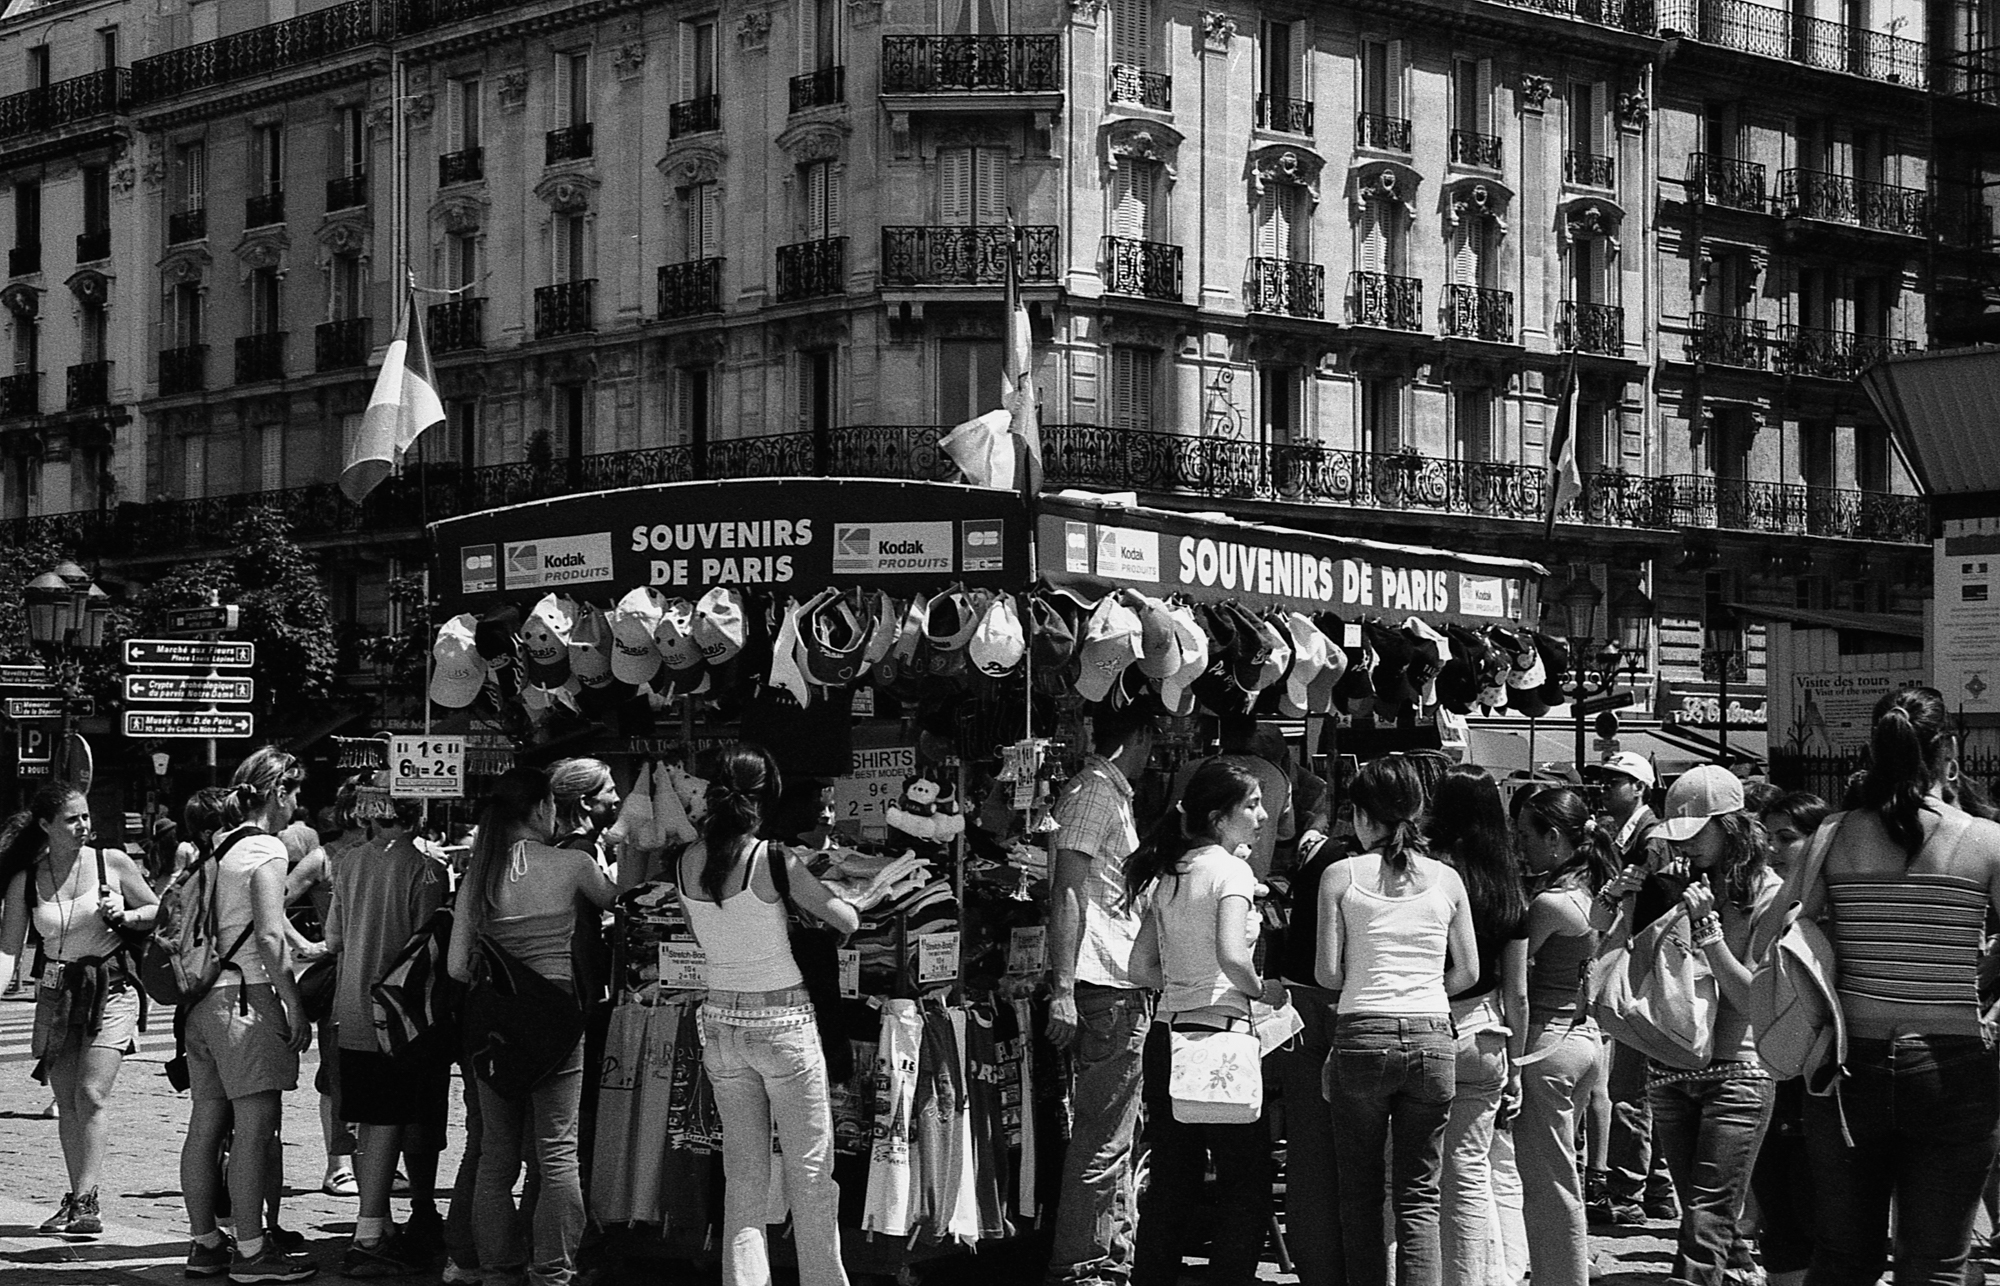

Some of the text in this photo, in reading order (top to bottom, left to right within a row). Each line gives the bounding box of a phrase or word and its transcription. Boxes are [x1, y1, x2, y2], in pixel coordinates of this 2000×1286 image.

[631, 518, 813, 551] SOUVENIRS
[879, 540, 924, 555] Kodak
[1121, 546, 1144, 561] Kodak
[544, 552, 586, 568] Kodak
[878, 558, 949, 568] PRODUITS
[544, 566, 610, 582] PRODUITS
[650, 555, 794, 586] DE PARIS
[1121, 563, 1157, 576] PRODUITS
[1179, 535, 1448, 613] SOUVENIRS DE PARIS
[156, 644, 188, 654] Marché
[208, 646, 235, 655] Fleurs
[171, 654, 191, 662] Place
[148, 680, 174, 691] Crypte
[1797, 675, 1890, 688] Visite des tours
[159, 690, 185, 699] parvis
[187, 690, 210, 698] Notre
[210, 690, 234, 699] Dame
[1815, 688, 1834, 696] Visit
[1835, 688, 1846, 696] of
[213, 717, 233, 726] Paris
[29, 730, 42, 753] P
[20, 766, 49, 774] 2 ROUES
[854, 770, 877, 780] BEST
[878, 767, 914, 779] MODELS
